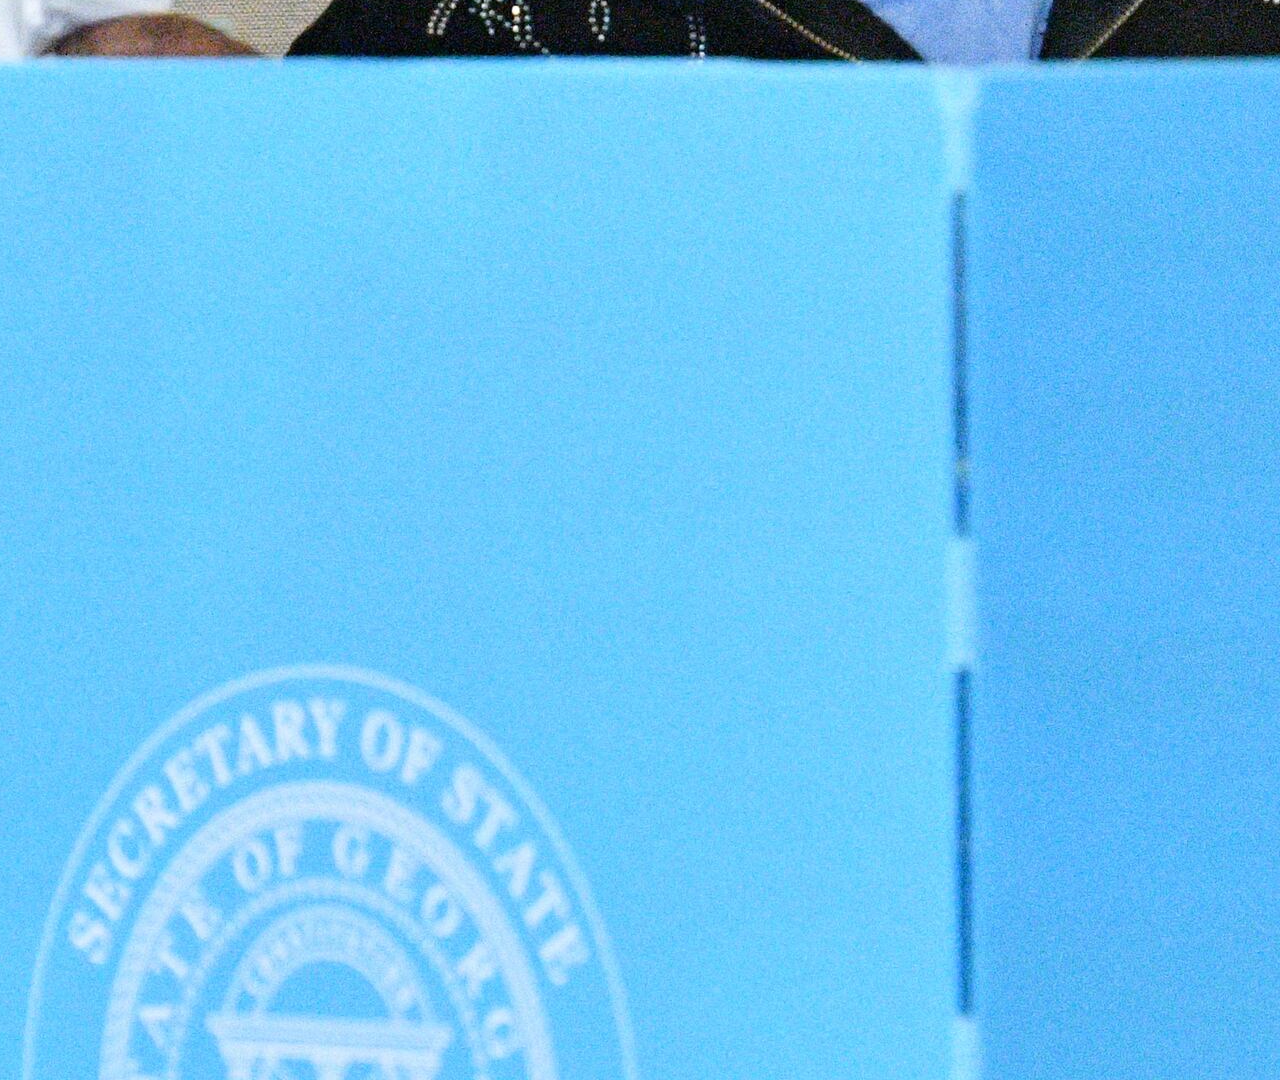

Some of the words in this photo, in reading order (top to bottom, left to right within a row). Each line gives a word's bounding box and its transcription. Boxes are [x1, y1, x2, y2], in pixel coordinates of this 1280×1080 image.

[68, 698, 347, 965] SECRETARY
[360, 708, 443, 784] OF
[442, 763, 591, 986] STATE
[232, 826, 303, 894] OF
[332, 825, 520, 1059] GEORG
